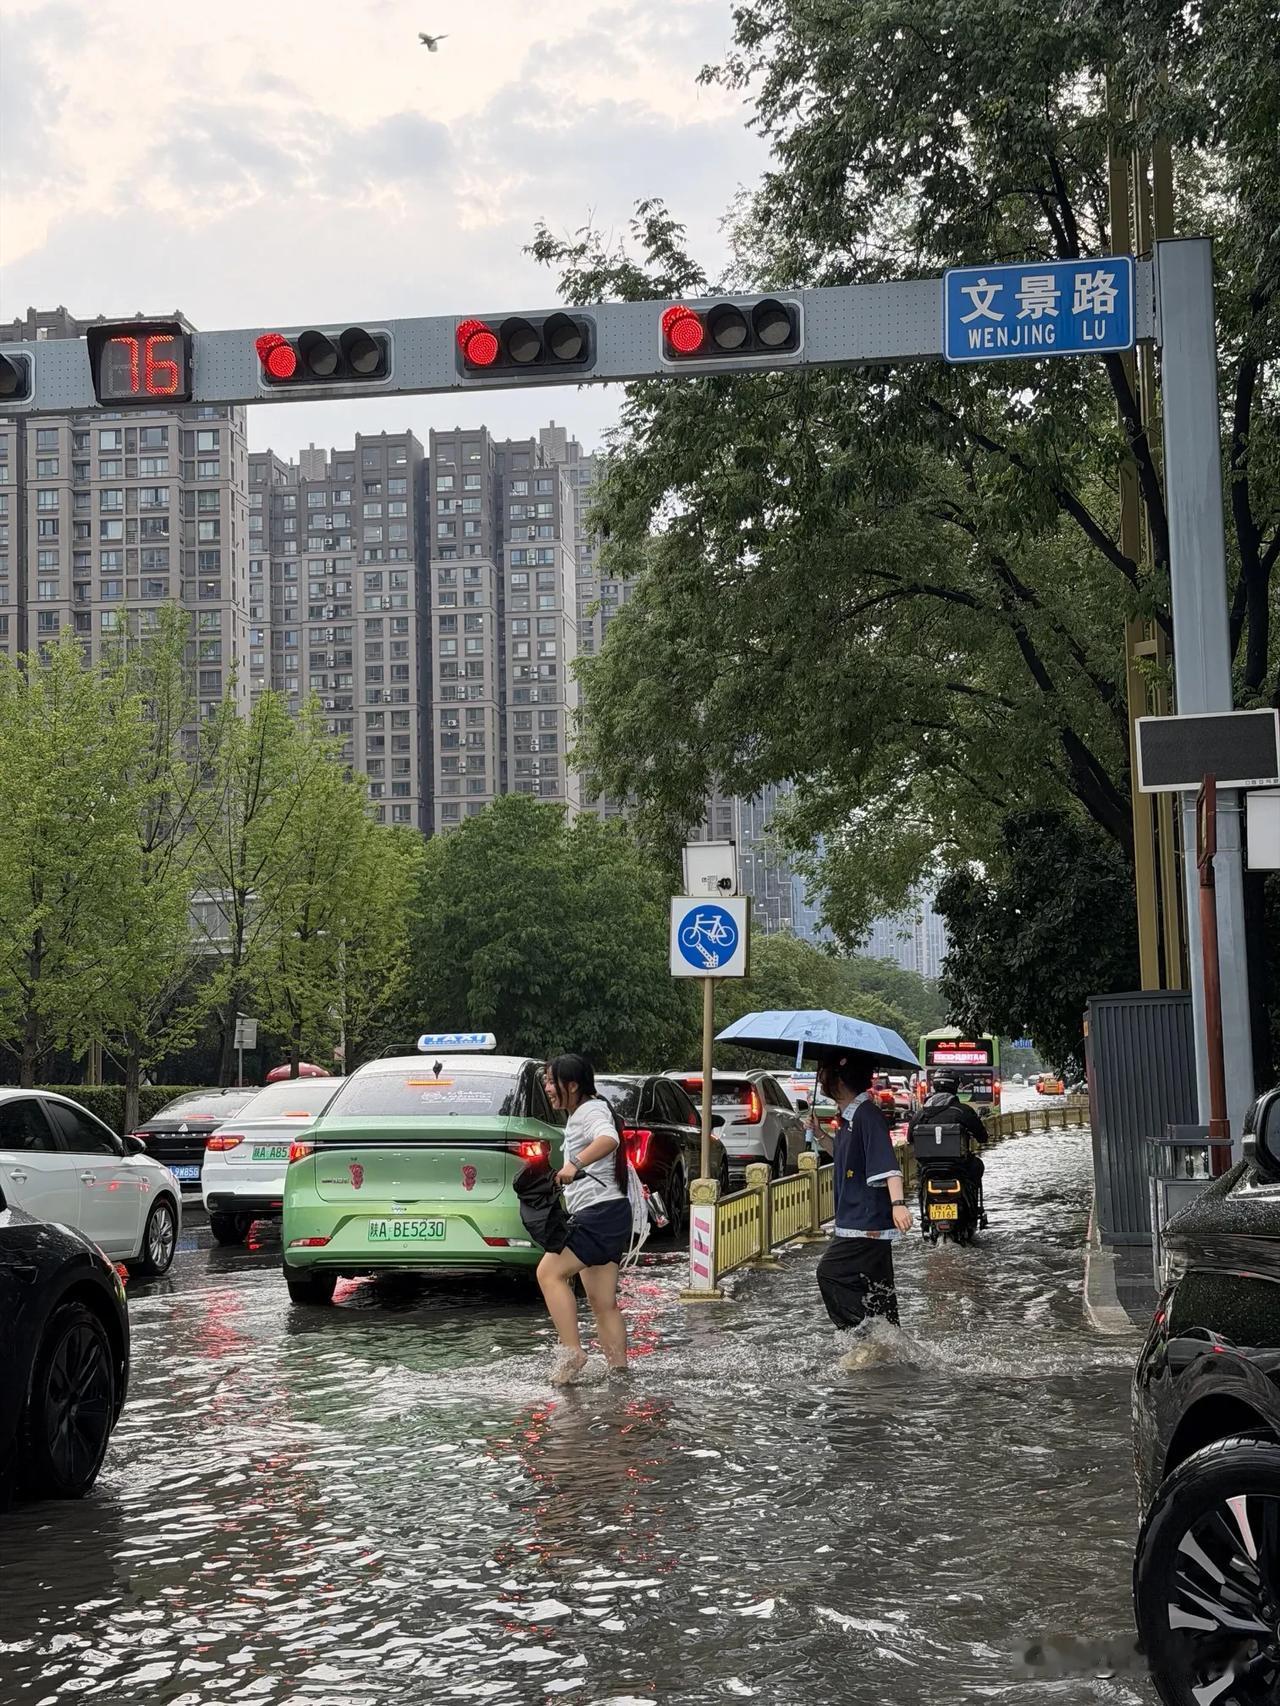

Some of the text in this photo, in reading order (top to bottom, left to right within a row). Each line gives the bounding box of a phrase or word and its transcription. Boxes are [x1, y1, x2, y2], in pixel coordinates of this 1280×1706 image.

[959, 269, 1120, 325] 文景路
[967, 318, 1107, 350] WENJING LU
[110, 335, 178, 395] 76
[369, 1221, 444, 1238] 陕A BE5230
